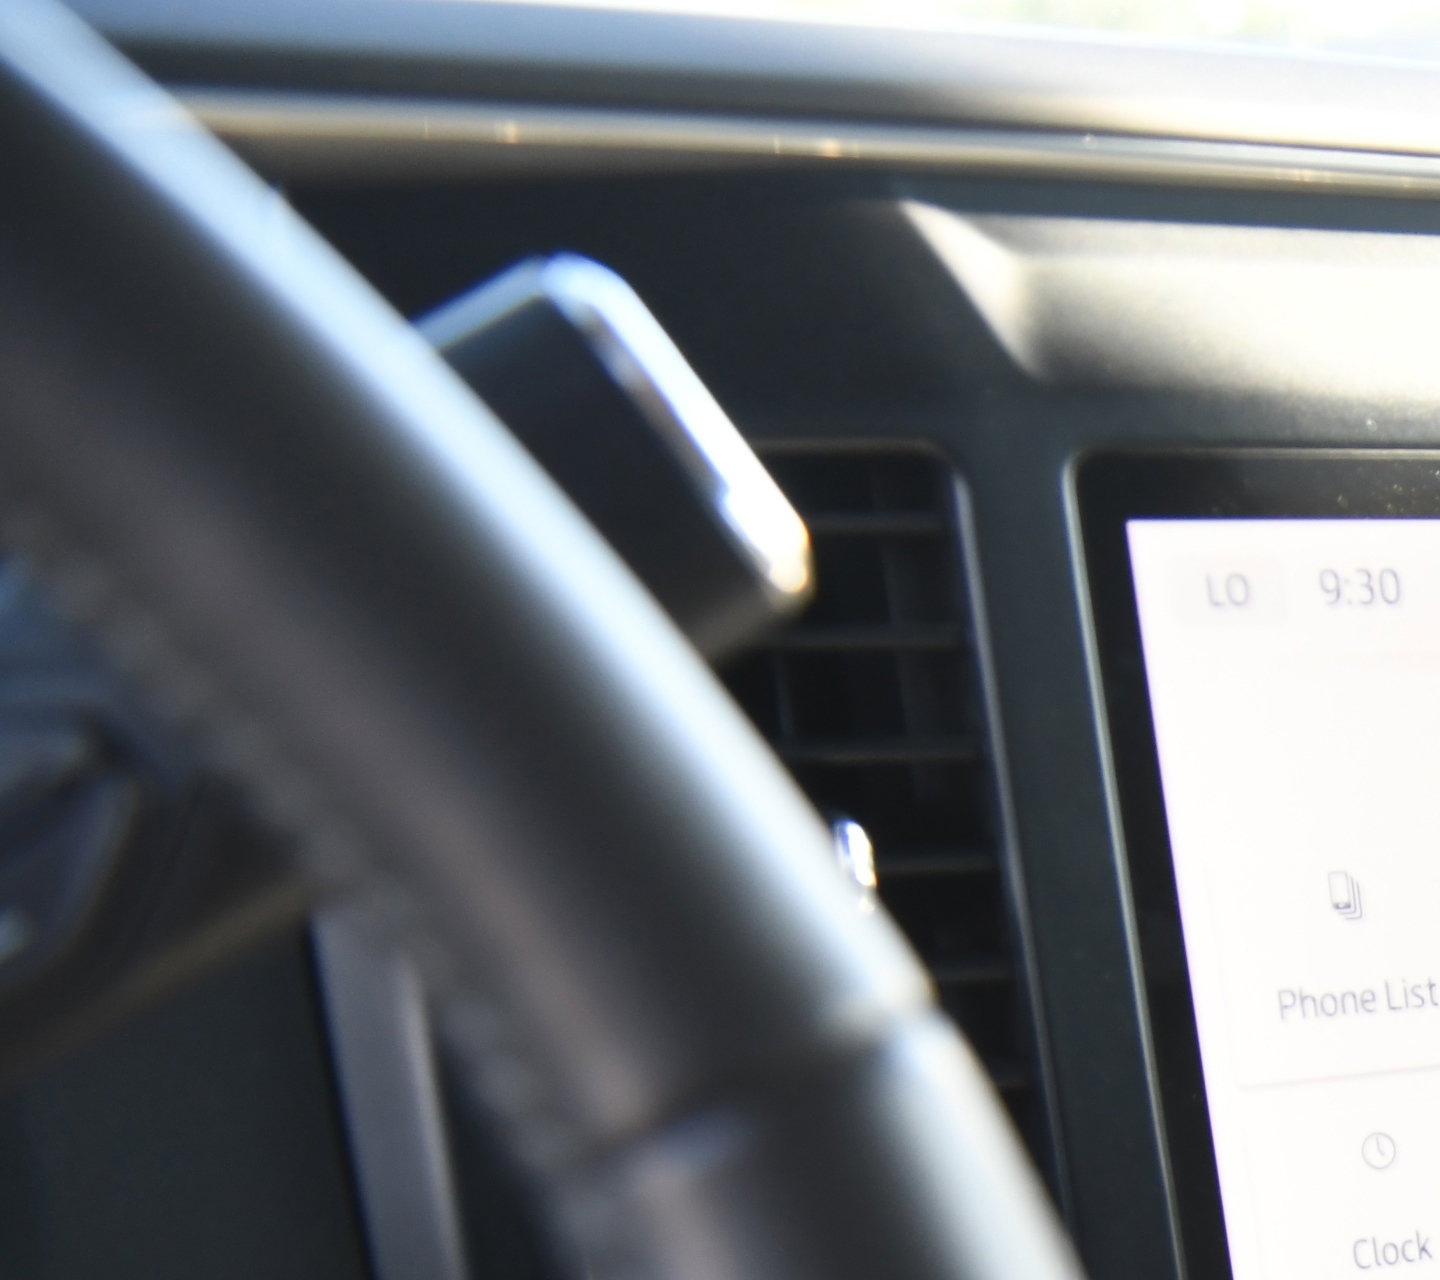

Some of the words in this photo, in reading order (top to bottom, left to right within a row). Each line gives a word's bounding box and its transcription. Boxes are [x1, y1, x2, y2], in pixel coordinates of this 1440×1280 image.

[1205, 571, 1250, 608] LO
[1318, 567, 1402, 606] 9:30
[1277, 984, 1376, 1022] Phone
[1385, 976, 1439, 1012] List
[1353, 1230, 1433, 1270] Clock
